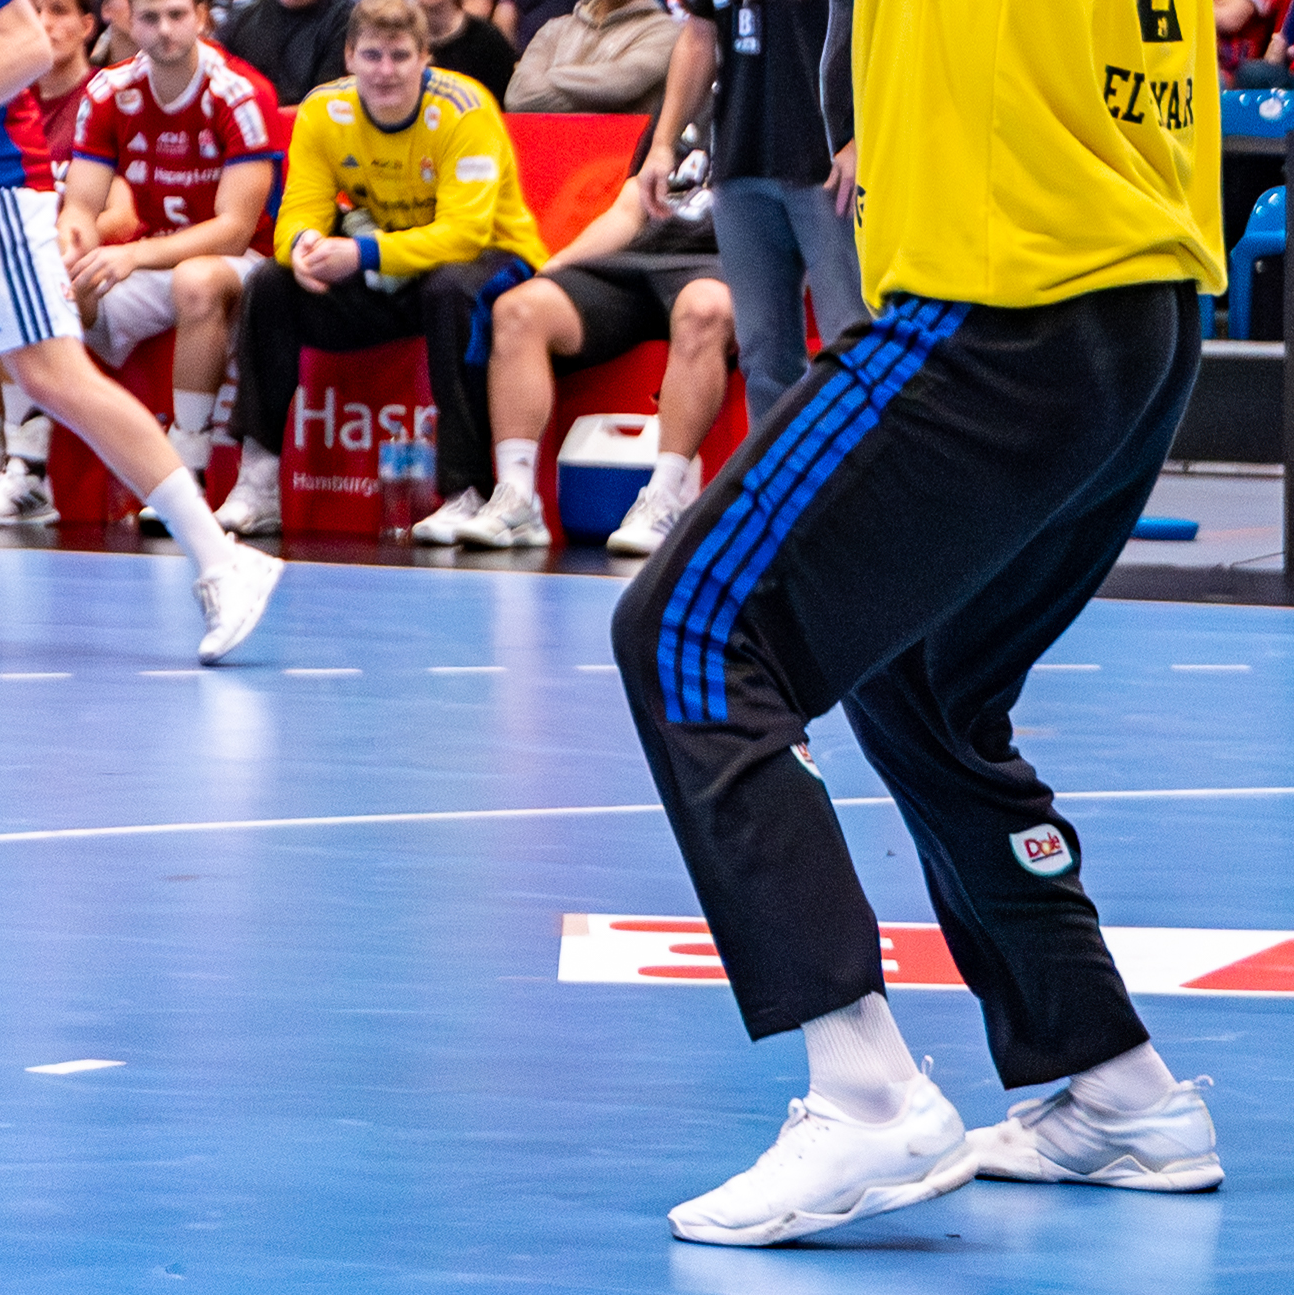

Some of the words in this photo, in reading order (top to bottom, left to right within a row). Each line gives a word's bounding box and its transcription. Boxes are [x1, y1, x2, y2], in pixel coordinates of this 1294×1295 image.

[1103, 64, 1145, 125] EL
[162, 195, 190, 225] 5
[1023, 831, 1062, 859] Dole
